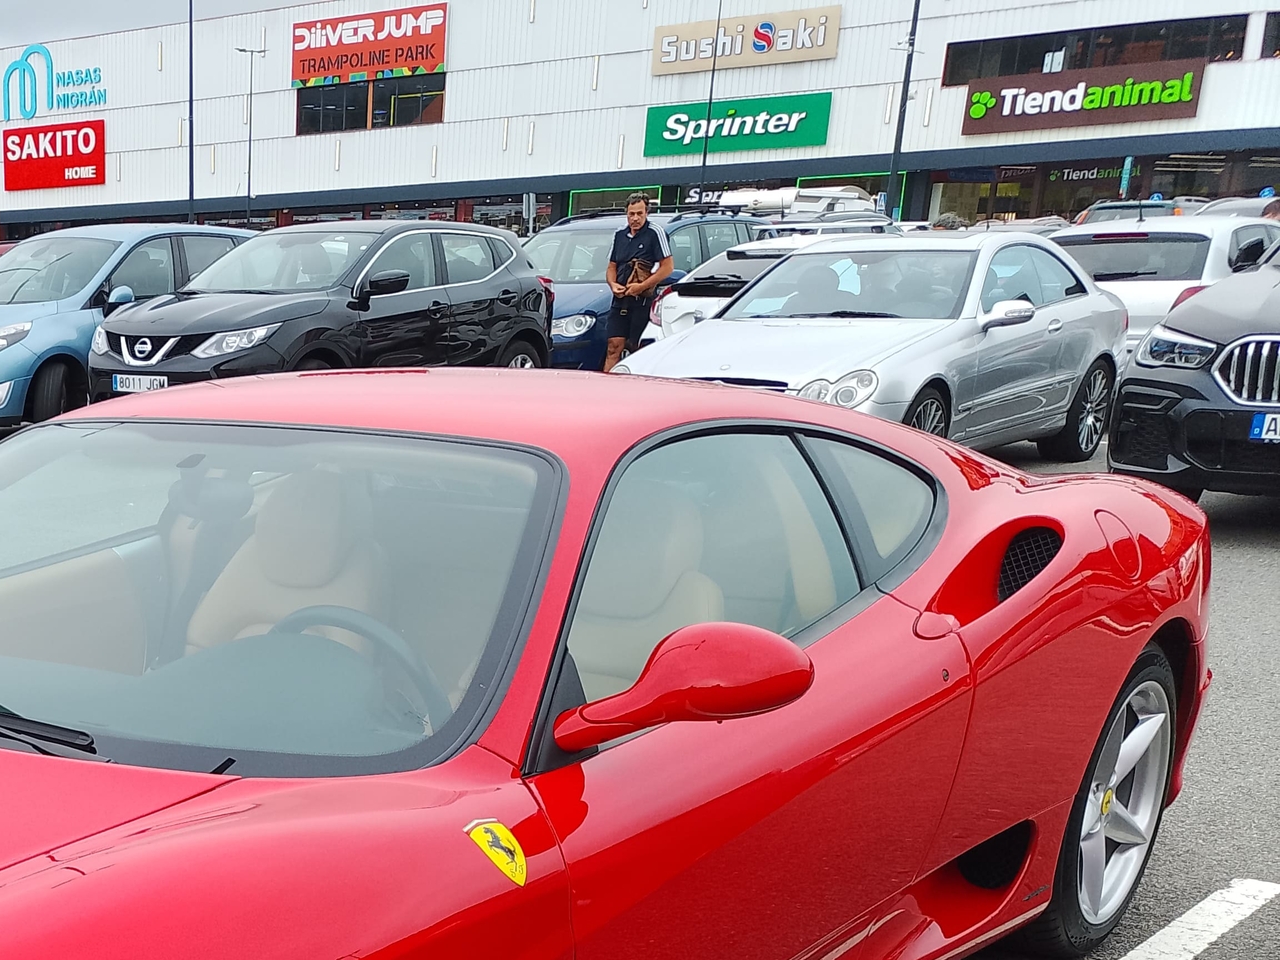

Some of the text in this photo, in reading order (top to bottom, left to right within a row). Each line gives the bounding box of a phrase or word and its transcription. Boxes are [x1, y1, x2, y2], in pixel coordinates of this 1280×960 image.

[377, 10, 444, 40] JUMP
[660, 16, 827, 63] Sushi Saki
[300, 43, 436, 74] TRAMPOLINE PARK
[56, 67, 102, 87] NASAS
[56, 87, 107, 109] NIGRÁN
[1000, 72, 1194, 116] Tiendanimal
[663, 109, 806, 145] Sprinter
[6, 127, 96, 161] SAKITO
[64, 166, 96, 179] HOME
[119, 377, 165, 391] 8011 JGM
